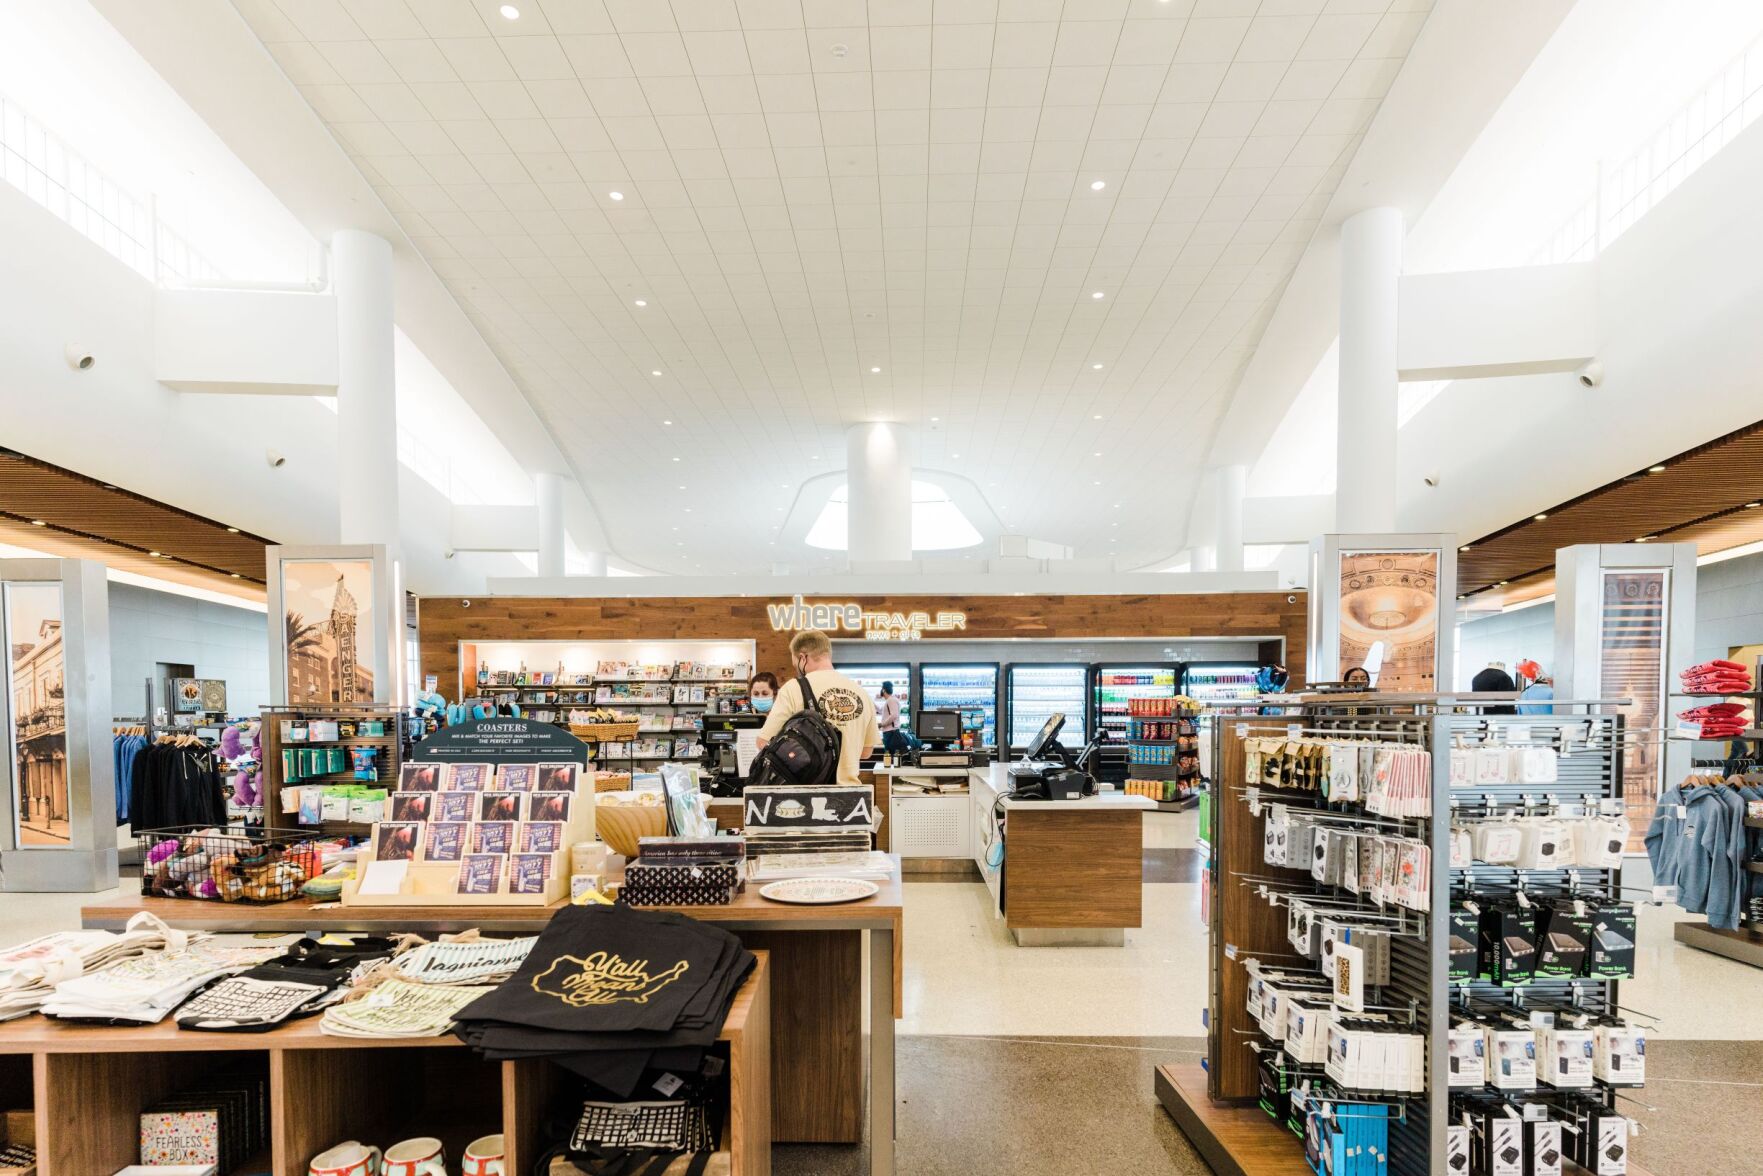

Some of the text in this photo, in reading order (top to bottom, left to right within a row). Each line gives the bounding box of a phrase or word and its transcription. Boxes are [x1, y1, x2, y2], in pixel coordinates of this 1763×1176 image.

[768, 595, 966, 630] where TRAVELER
[866, 630, 890, 640] news
[340, 612, 353, 703] SAENGER
[477, 723, 527, 732] COASTERS
[156, 1135, 202, 1149] FEARLESS
[169, 1148, 188, 1161] BOX
